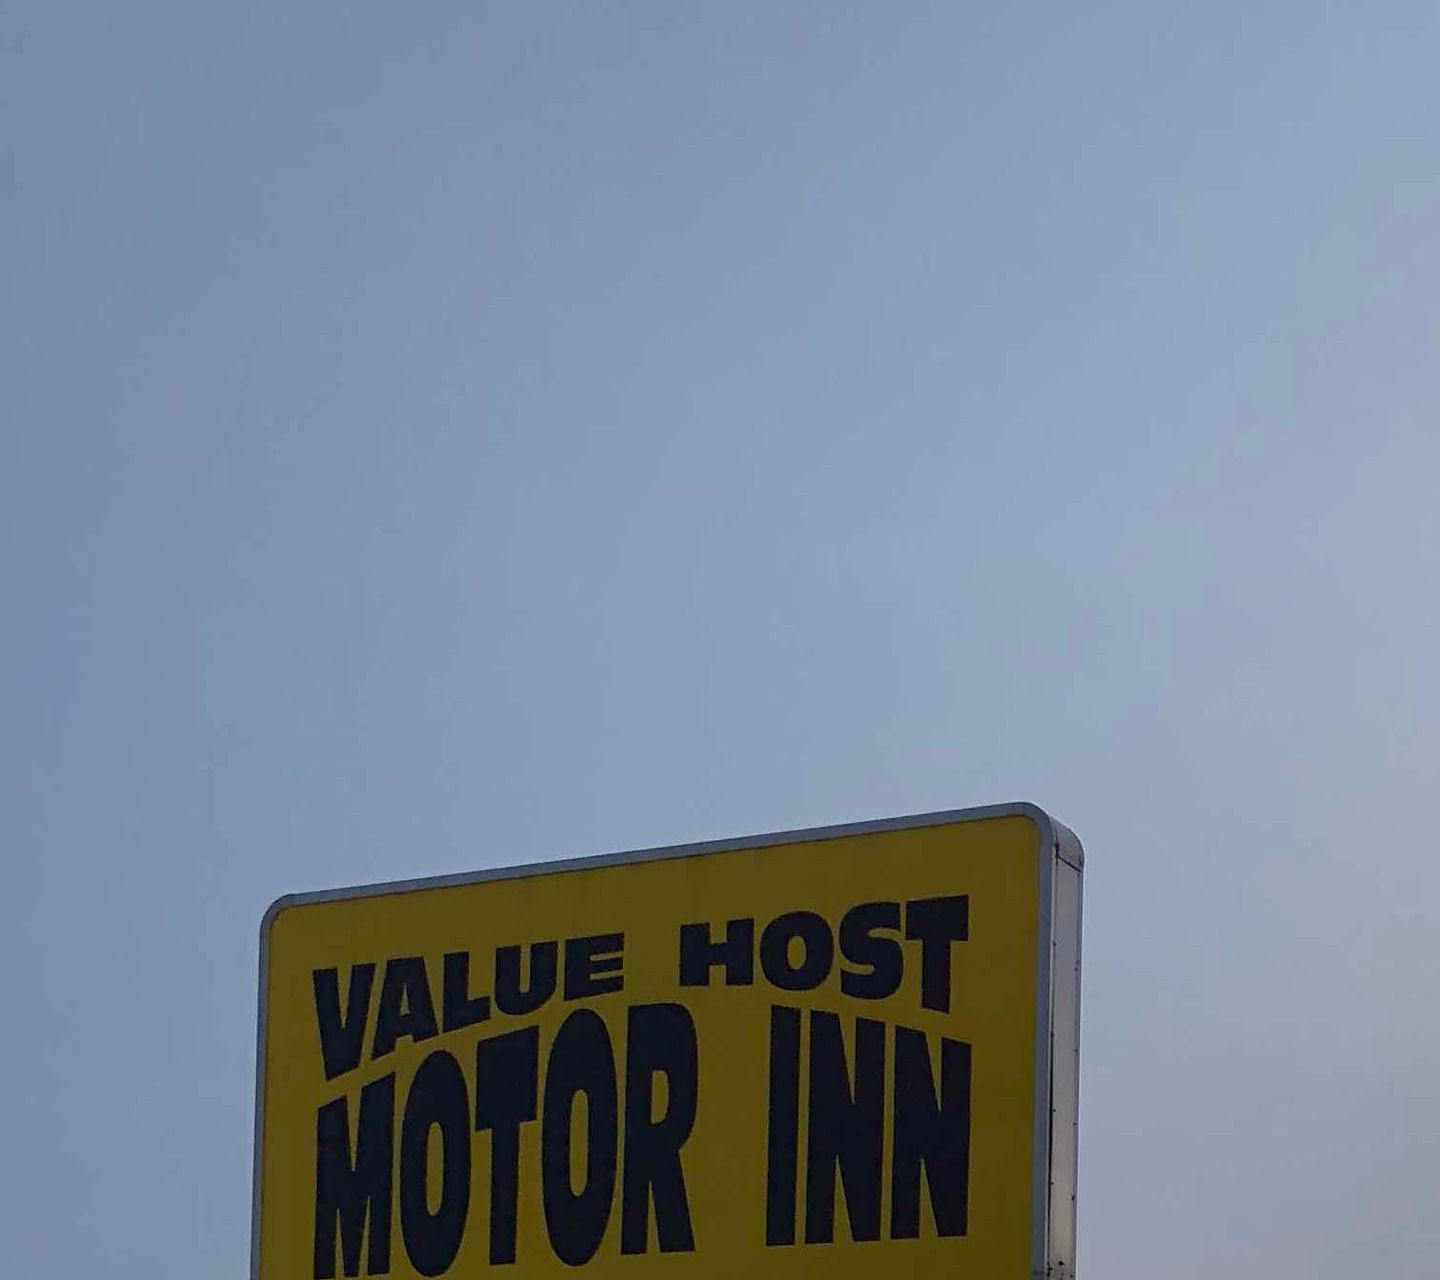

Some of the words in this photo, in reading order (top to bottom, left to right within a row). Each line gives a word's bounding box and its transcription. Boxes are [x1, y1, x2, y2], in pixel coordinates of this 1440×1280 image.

[313, 932, 625, 1080] VALUE
[679, 894, 969, 1014] HOST
[313, 1003, 698, 1280] MOTOR
[765, 1006, 972, 1247] INN
